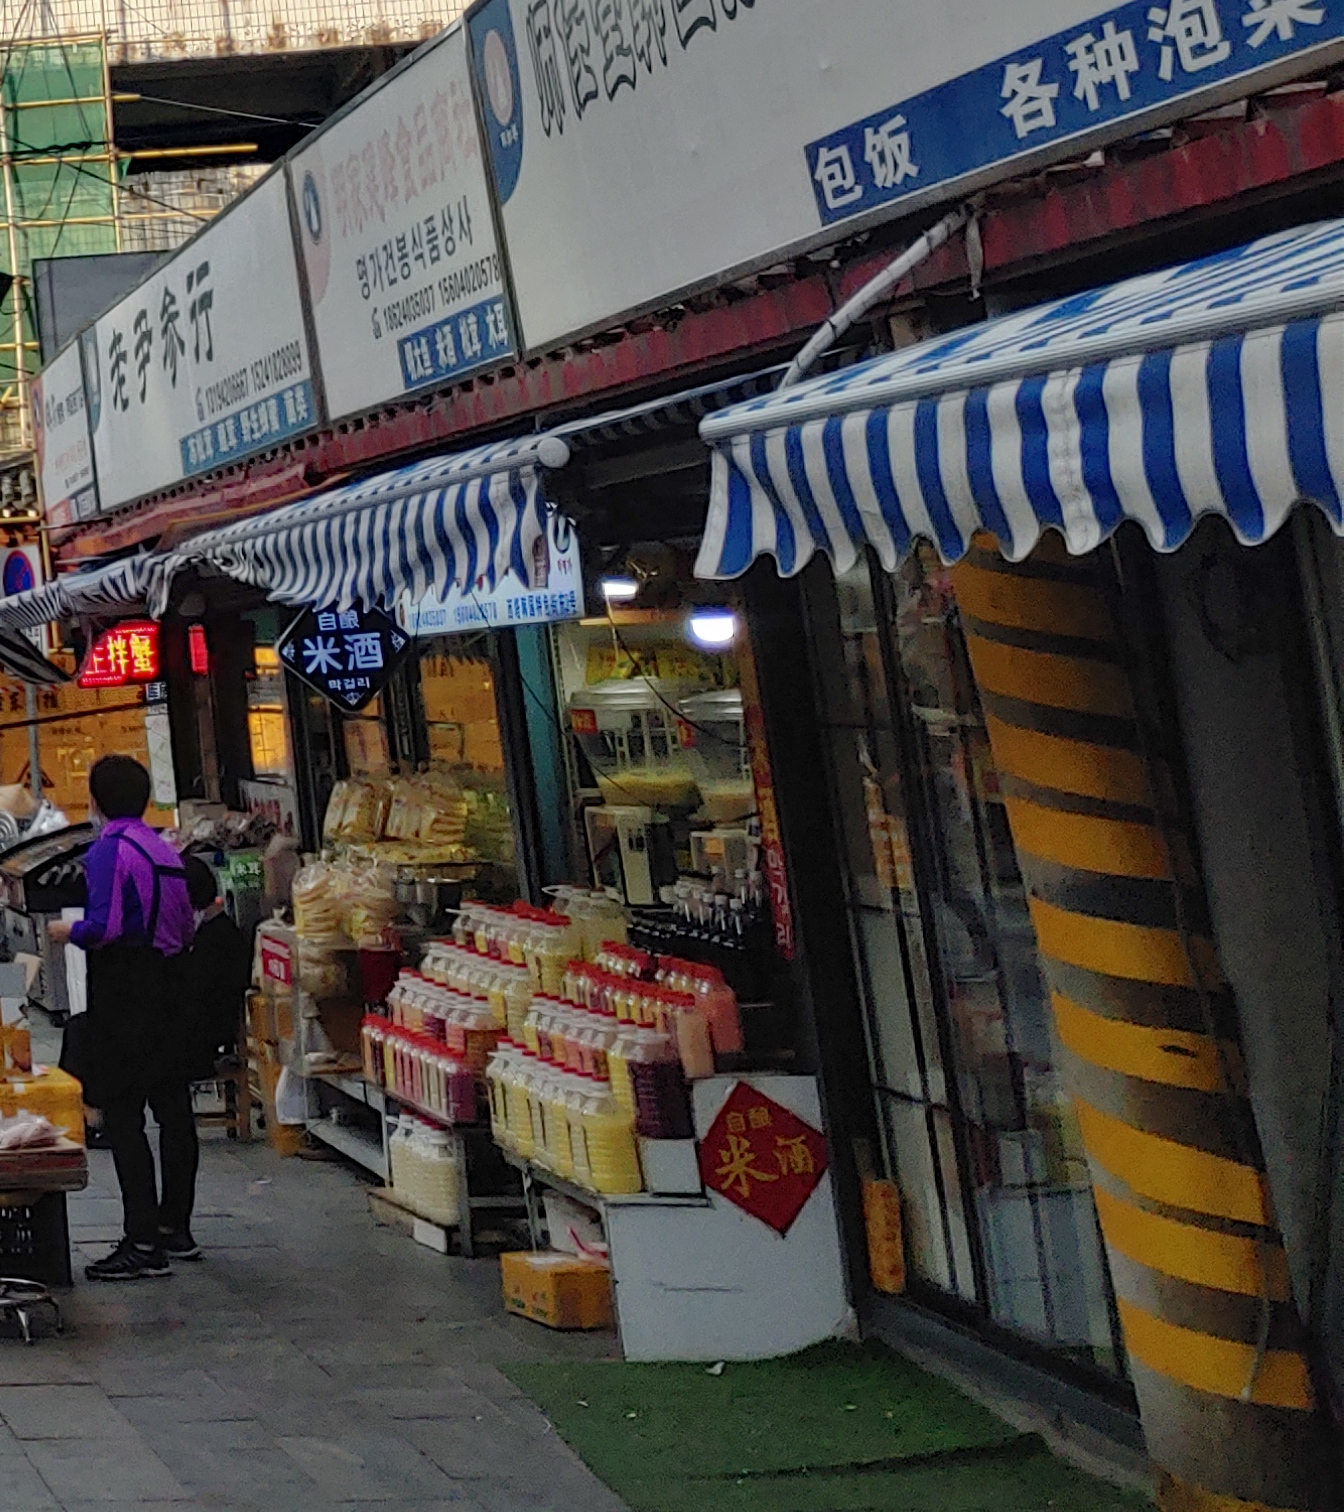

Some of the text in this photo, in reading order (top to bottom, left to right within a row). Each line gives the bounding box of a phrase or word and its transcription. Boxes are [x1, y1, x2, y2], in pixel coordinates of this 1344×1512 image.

[813, 115, 920, 214] 包饭
[318, 609, 360, 631] 自酿
[303, 632, 384, 674] 米酒
[714, 1133, 816, 1200] 米酒
